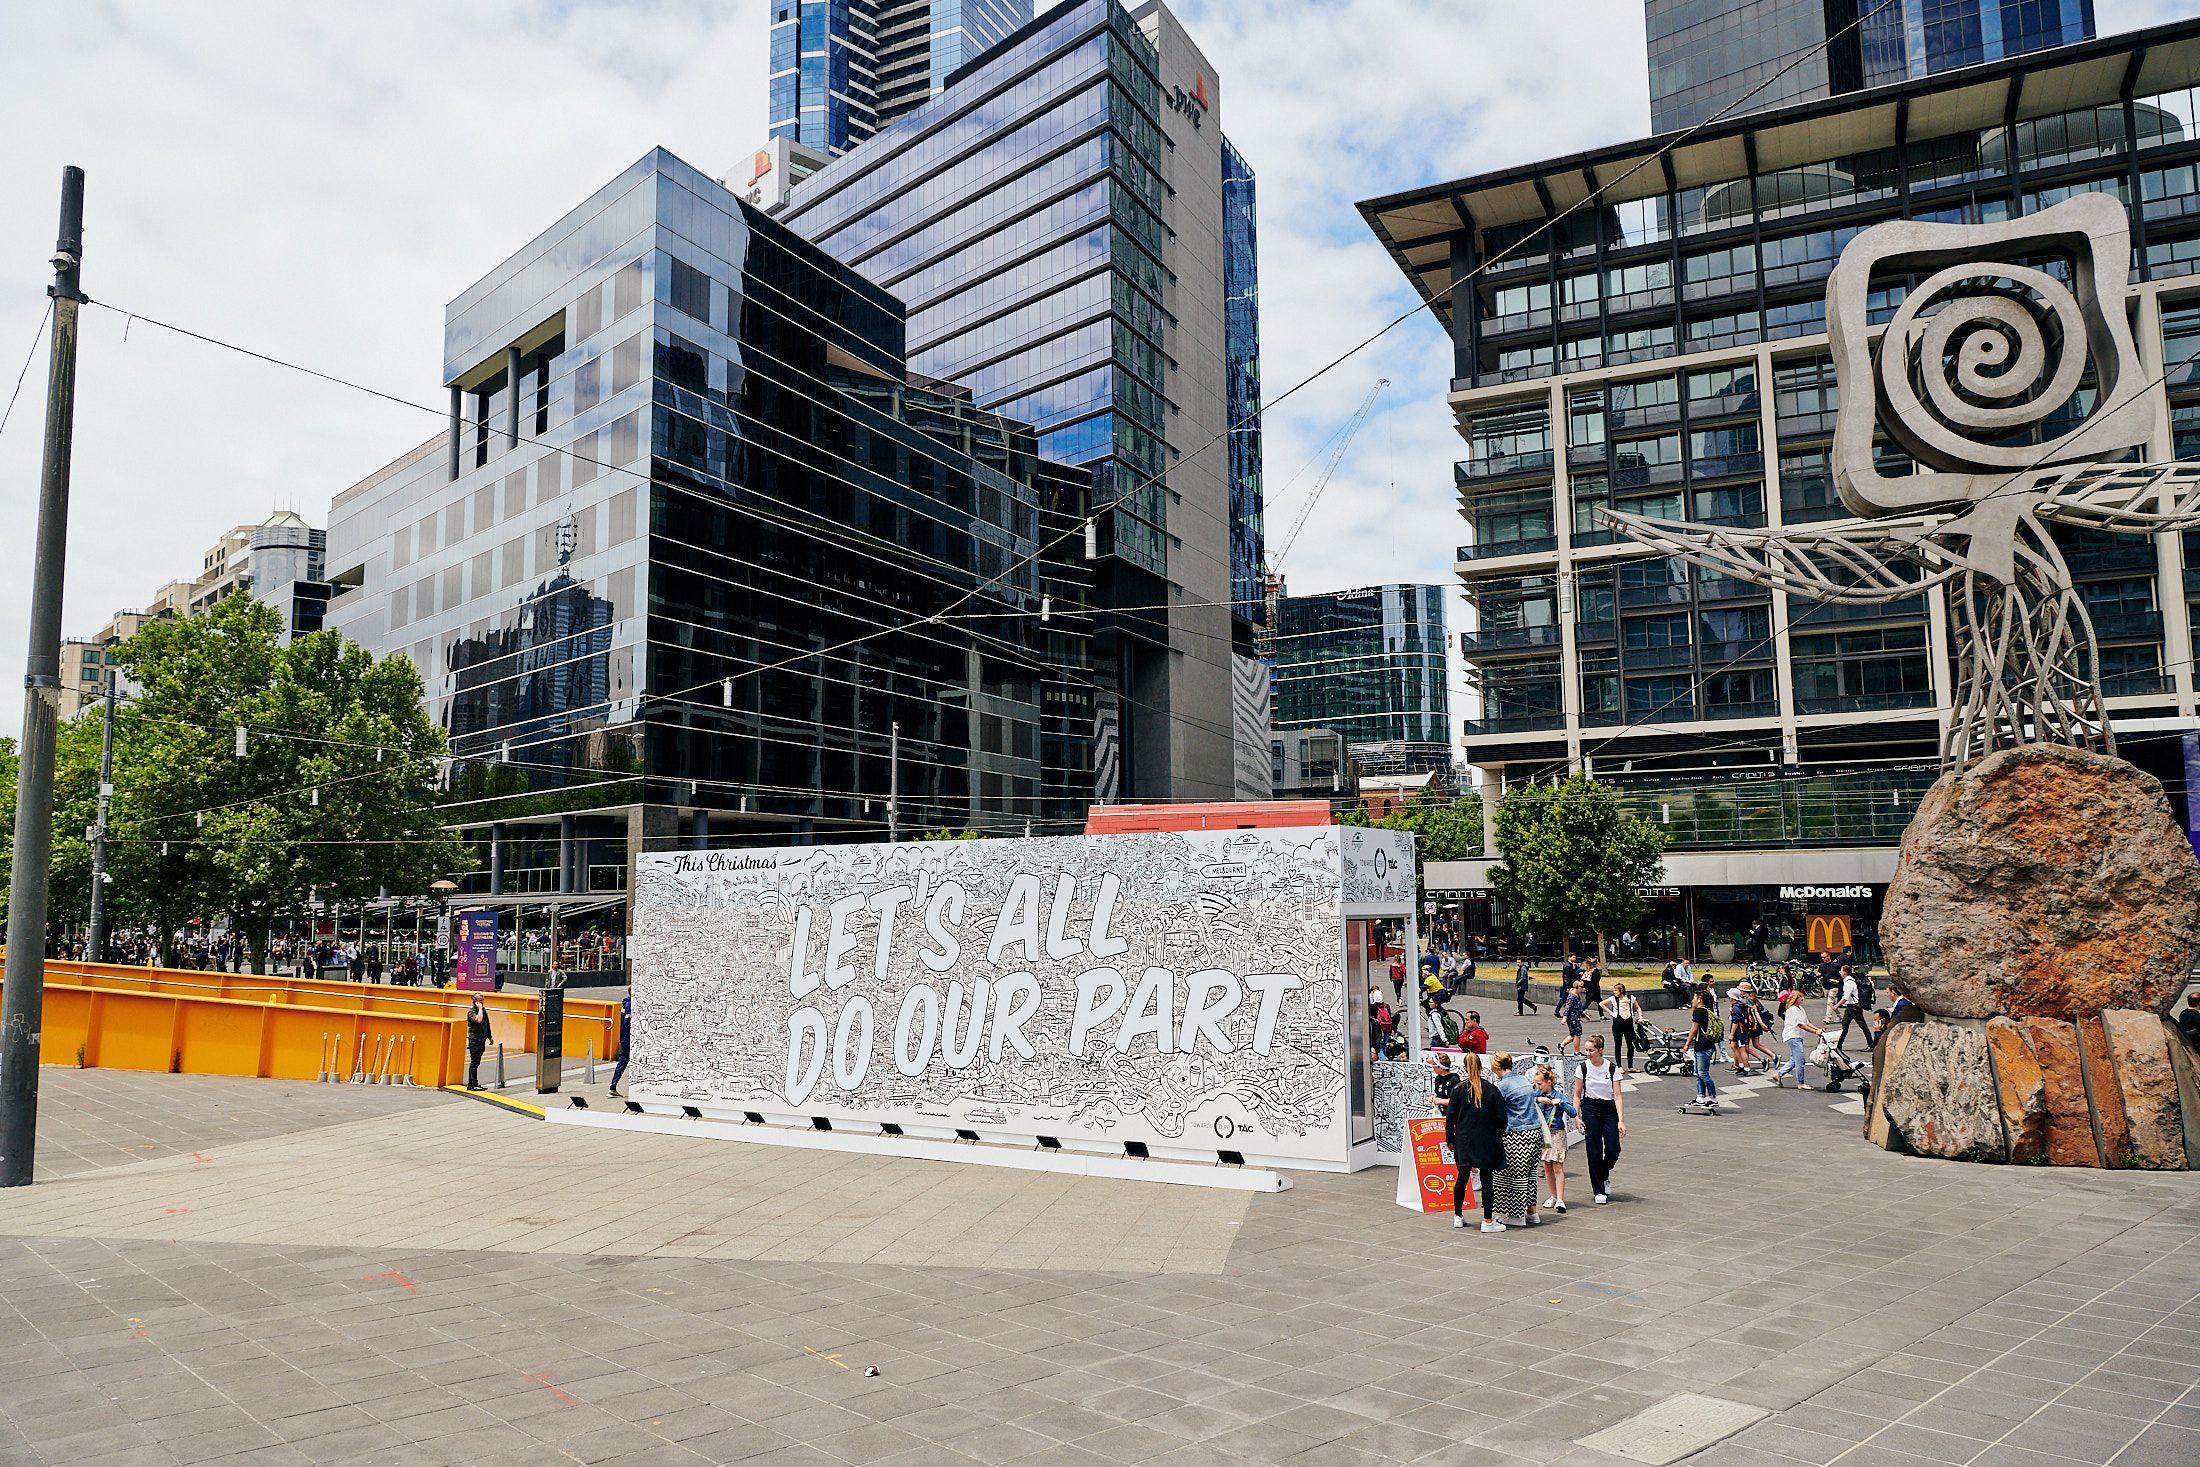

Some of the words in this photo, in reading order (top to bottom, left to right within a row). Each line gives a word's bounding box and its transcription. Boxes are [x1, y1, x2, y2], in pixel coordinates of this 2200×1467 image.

[1173, 84, 1201, 130] pwc
[674, 853, 704, 874] This
[706, 852, 777, 872] Christmas
[1211, 865, 1244, 875] MELBOURNE
[1780, 885, 1873, 899] McDonald's
[789, 868, 967, 1001] LET'S
[986, 871, 1130, 966] ALL
[784, 995, 875, 1107] DO
[893, 970, 1043, 1077] OUR
[1068, 966, 1304, 1057] PART
[1237, 1124, 1254, 1133] TAC
